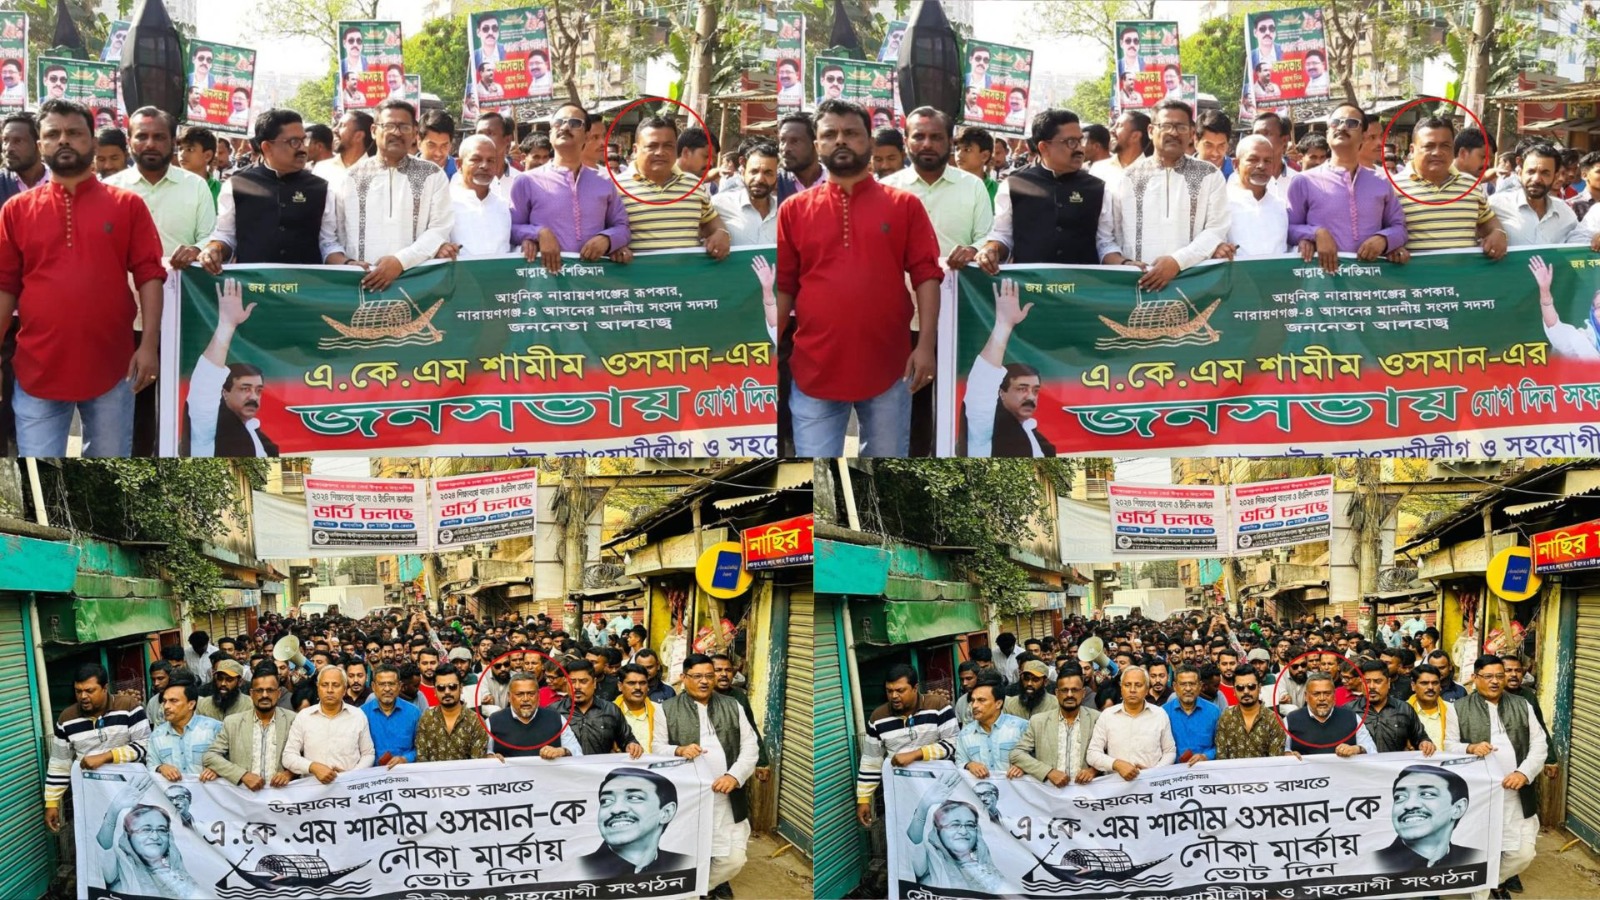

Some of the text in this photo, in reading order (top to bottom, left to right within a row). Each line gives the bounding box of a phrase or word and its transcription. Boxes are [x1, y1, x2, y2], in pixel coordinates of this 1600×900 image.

[550, 264, 605, 278] র্বশক্তিমান
[1327, 264, 1382, 278] র্বশক্তিমান
[248, 282, 299, 294] জয় বাংলা
[495, 289, 543, 305] আধুনিক
[548, 288, 630, 303] নারায়ণগঞ্জের
[1025, 282, 1075, 294] জয় বাংলা
[1272, 289, 1320, 305] আধুনিক
[1325, 288, 1406, 303] নারায়ণগঞ্জের
[544, 304, 595, 318] আসনের
[600, 302, 645, 316] মাননীয়
[649, 301, 682, 313] সংসদ
[687, 299, 719, 312] সদস্য
[1320, 305, 1372, 318] আসনের
[1377, 302, 1422, 316] মাননীয়
[1425, 301, 1459, 313] সংসদ
[1464, 299, 1495, 312] সদস্য
[508, 317, 673, 334] জননেতা আলহাজ্ব
[1285, 317, 1451, 334] জননেতা আলহাজ্ব
[480, 345, 588, 383] শামীম
[1258, 345, 1362, 383] শামীম
[286, 376, 778, 438] জনসভায় যোগ দিন
[1062, 385, 1467, 438] জনসভায়
[1471, 384, 1516, 417] যোগ
[1517, 377, 1558, 414] দিন
[703, 441, 721, 457] ও
[1480, 441, 1498, 457] ও
[1503, 425, 1600, 457] সহযোগী
[311, 492, 329, 502] ২০২৪
[440, 492, 455, 501] ২০২৪
[440, 494, 533, 517] ভর্তি চলছে
[1115, 498, 1132, 508] ২০২৪
[1239, 498, 1254, 507] ২০২৪
[312, 503, 413, 521] ভর্তি চলছে
[1115, 509, 1214, 527] ভর্তি চলছে
[1239, 500, 1329, 522] ভর্তি চলছে
[749, 526, 802, 556] নাছির
[1538, 531, 1589, 560] নাছির
[268, 780, 534, 816] উন্নয়নের ধারা অব্যাহত রাখতে
[1073, 776, 1330, 811] উন্নয়নের ধারা অব্যাহত রাখতে
[344, 802, 427, 841] শামীম
[435, 799, 588, 835] ওসমান-কে
[1146, 798, 1226, 836] শামীম
[1234, 795, 1381, 831] ওসমান-কে
[378, 832, 566, 873] নৌকা মার্কায়
[1180, 828, 1361, 869] নৌকা মার্কায়
[403, 868, 544, 890] ভোট দিন
[1204, 862, 1338, 883] ভোট দিন
[606, 875, 687, 896] সংগঠন
[1276, 887, 1296, 898] ও
[1304, 876, 1394, 897] সহযোগী
[1401, 869, 1479, 889] সংগঠন
